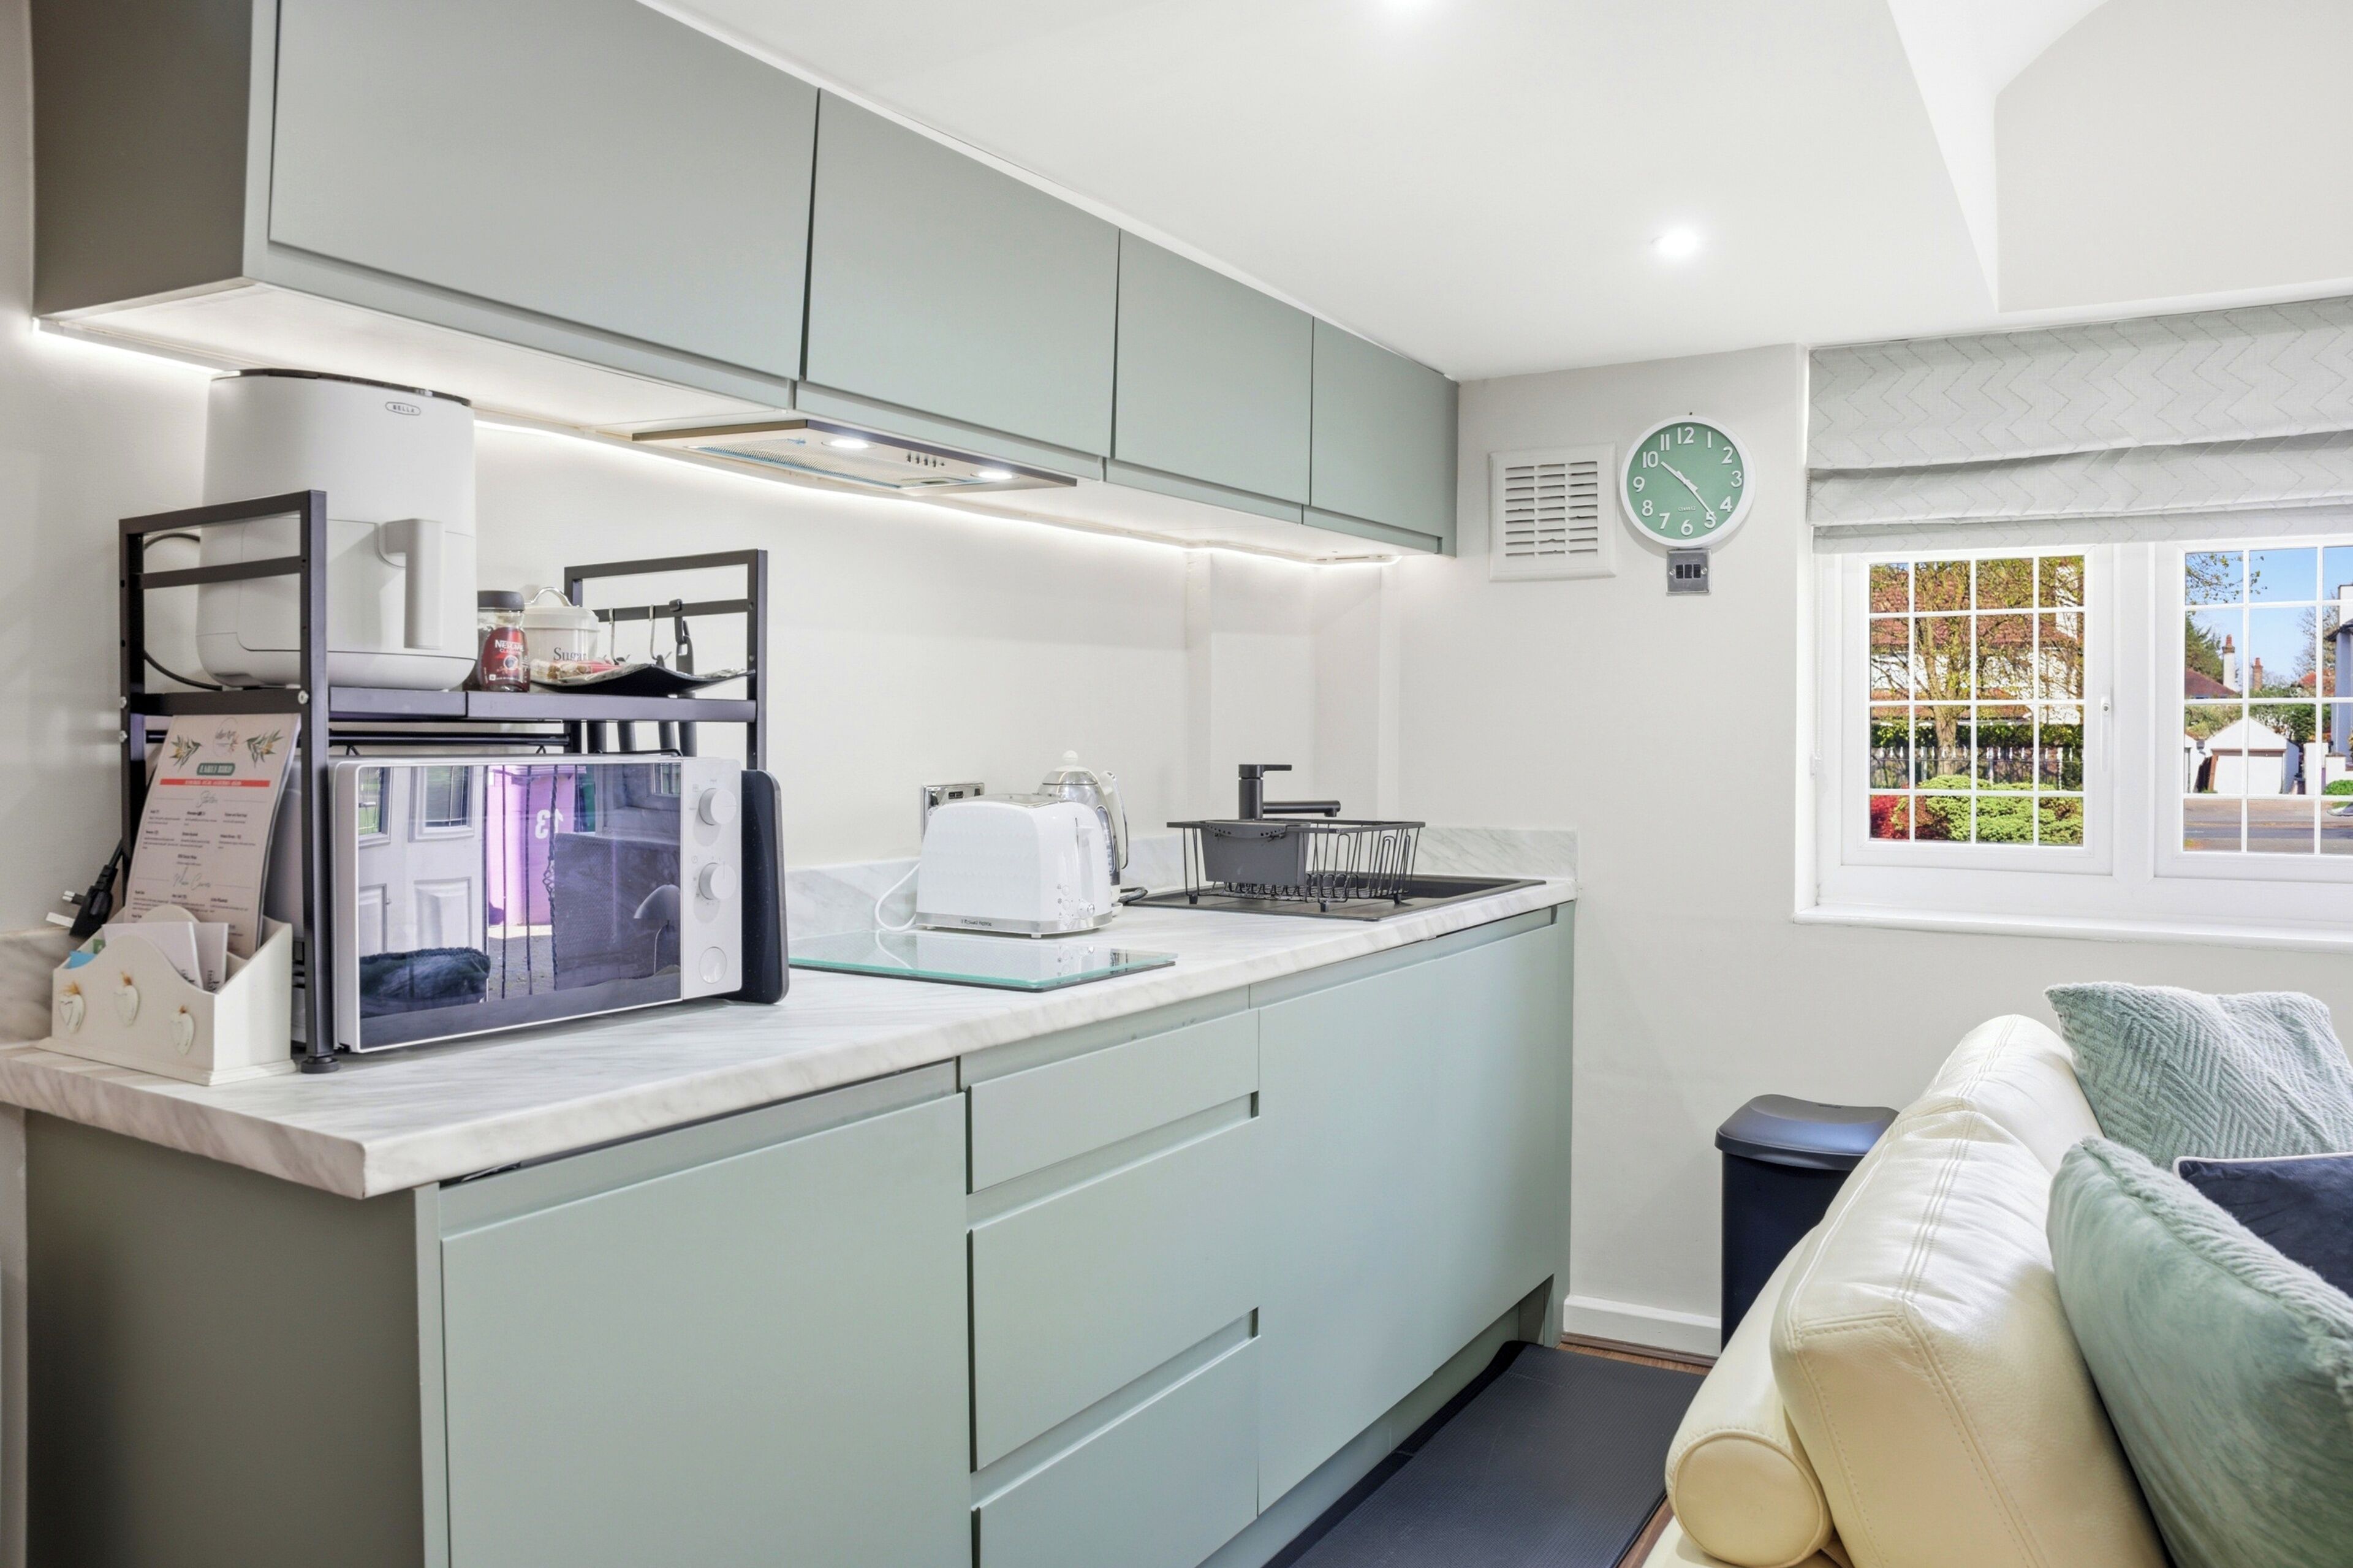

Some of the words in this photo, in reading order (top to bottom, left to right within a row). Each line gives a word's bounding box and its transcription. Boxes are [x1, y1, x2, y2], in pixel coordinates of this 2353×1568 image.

[1661, 434, 1670, 451] 11
[1677, 426, 1694, 444] 12
[1707, 431, 1711, 449] 1
[1643, 450, 1659, 468] 10
[1721, 446, 1733, 464] 2
[1633, 476, 1645, 493] 9
[1730, 471, 1743, 488] 3
[1642, 499, 1653, 517] 8
[1719, 496, 1733, 512] 4
[1659, 512, 1670, 529] 7
[1681, 519, 1693, 536] 6
[1703, 511, 1716, 529] 5
[553, 647, 586, 662] Sugar
